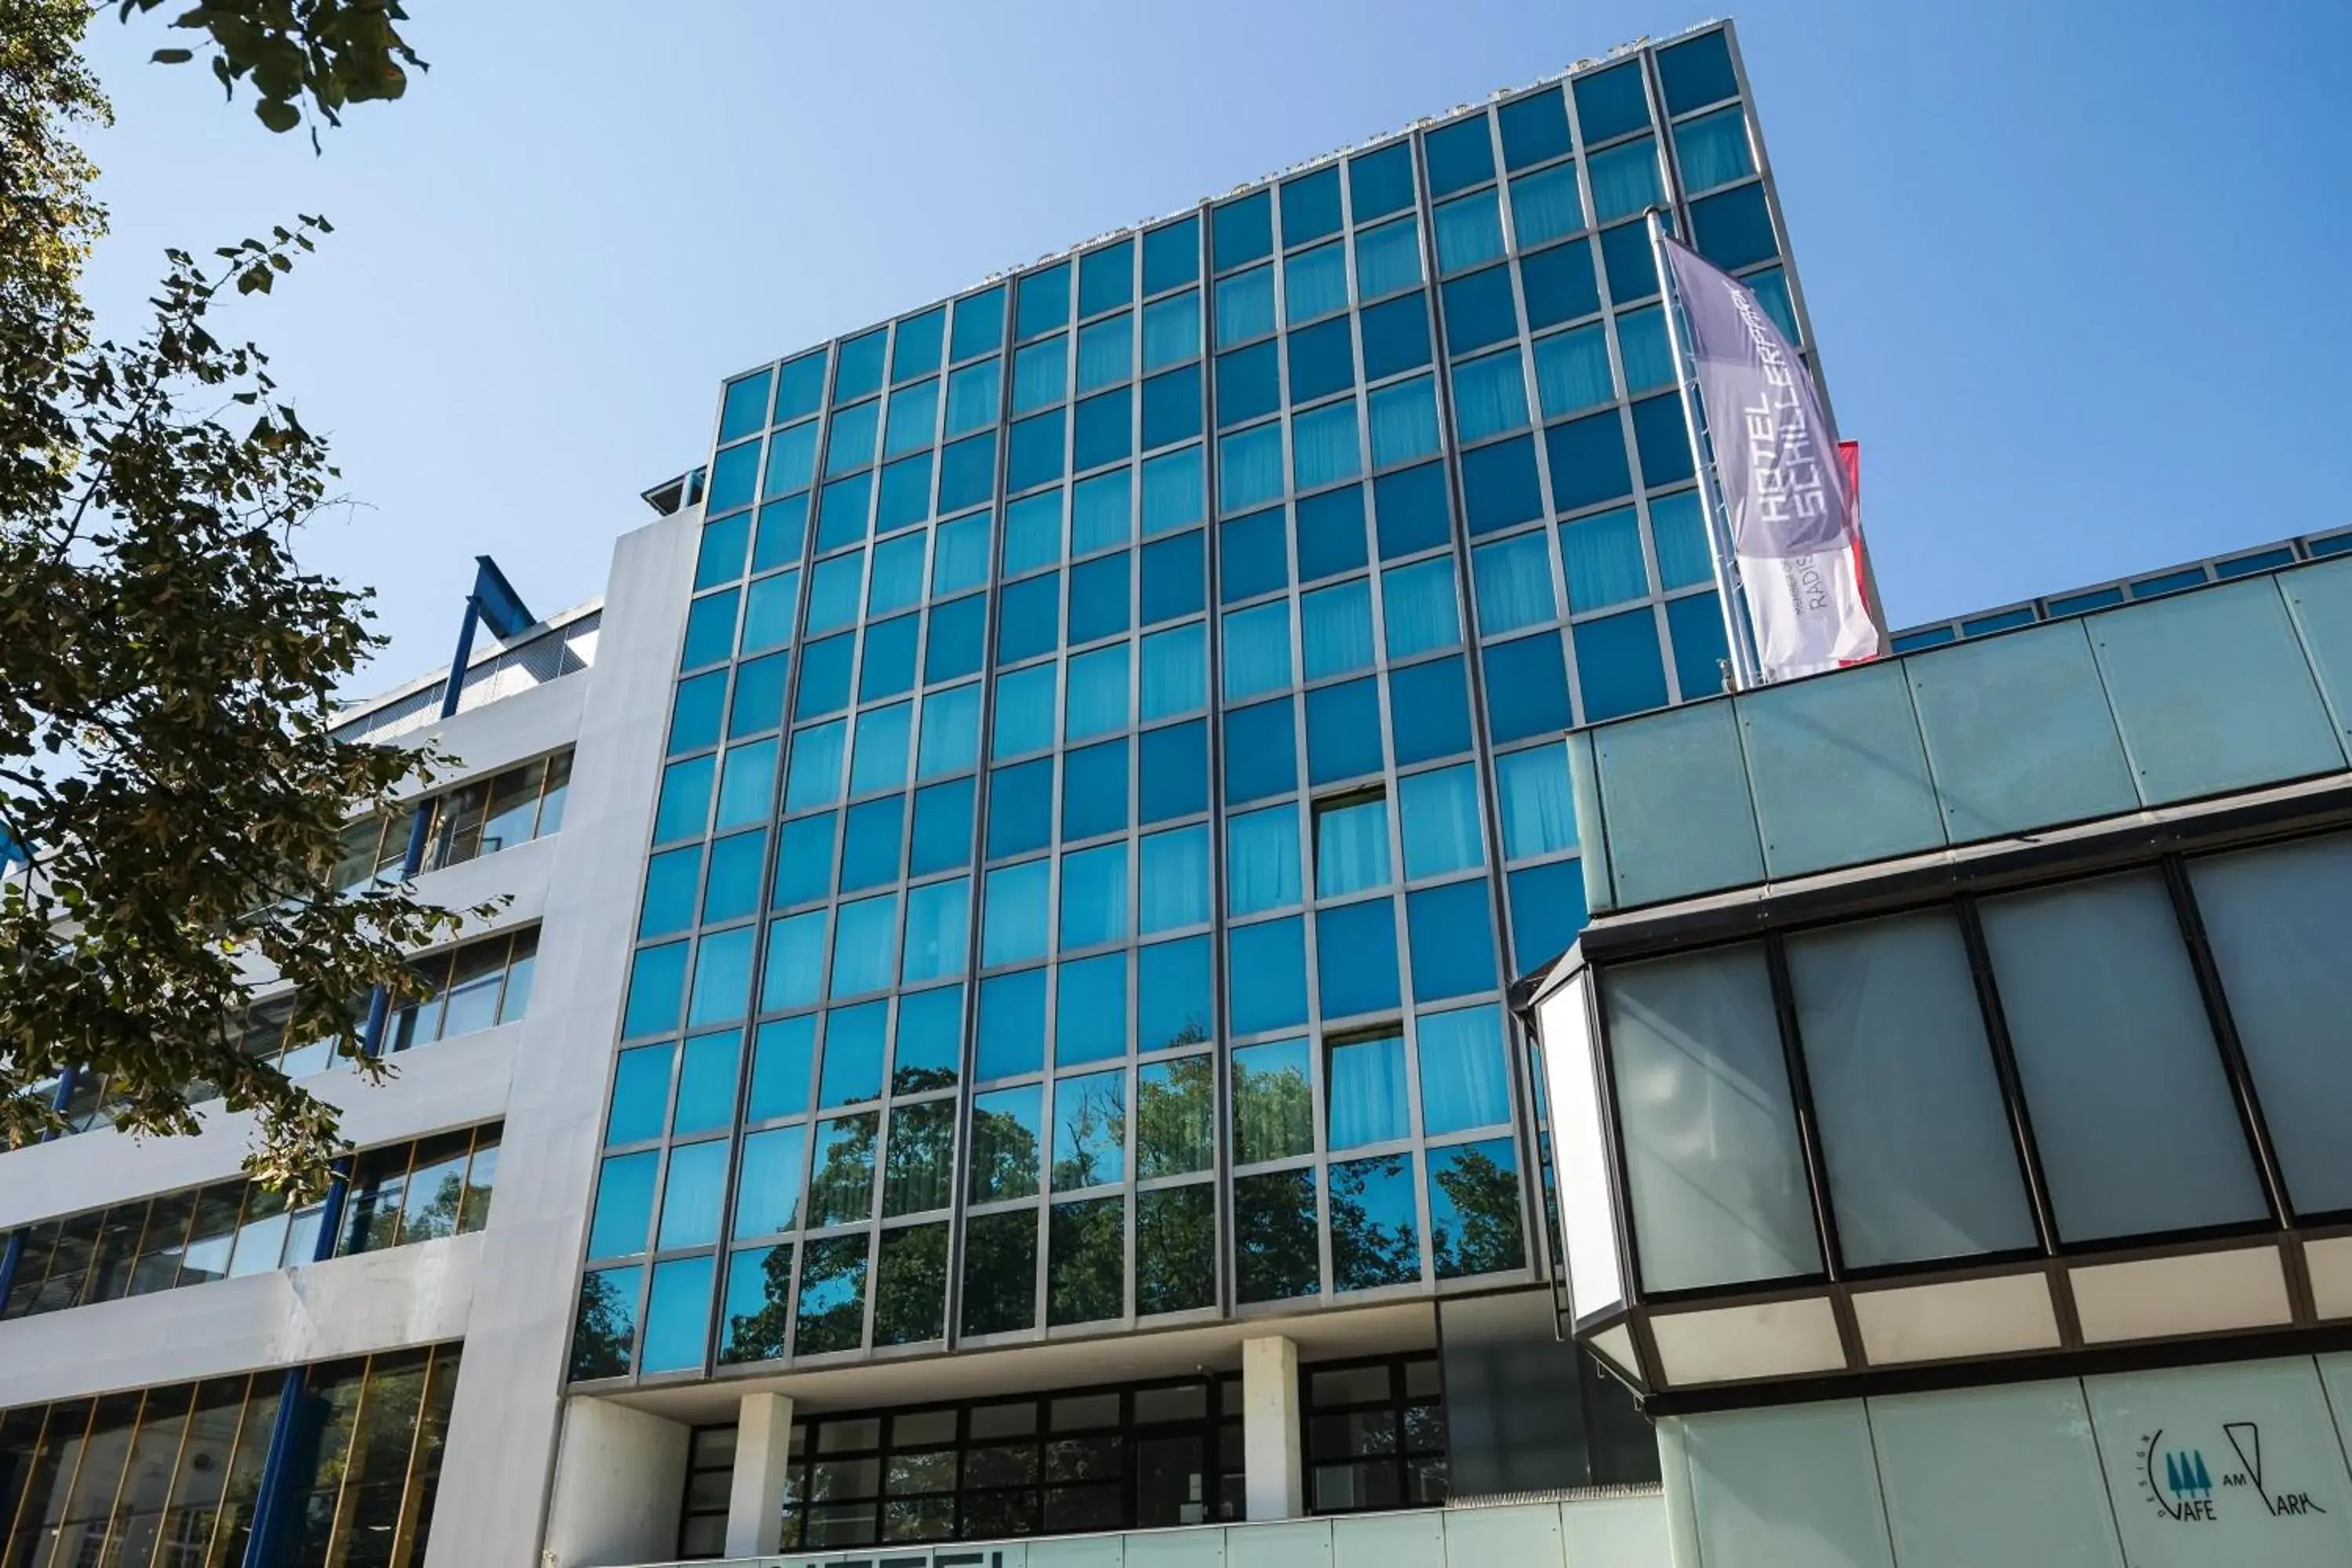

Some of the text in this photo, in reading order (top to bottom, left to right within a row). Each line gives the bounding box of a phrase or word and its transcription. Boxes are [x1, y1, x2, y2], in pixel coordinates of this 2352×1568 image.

[1744, 392, 1791, 523] HOTEL
[2223, 1421, 2327, 1517] PARK
[2223, 1473, 2248, 1486] AM
